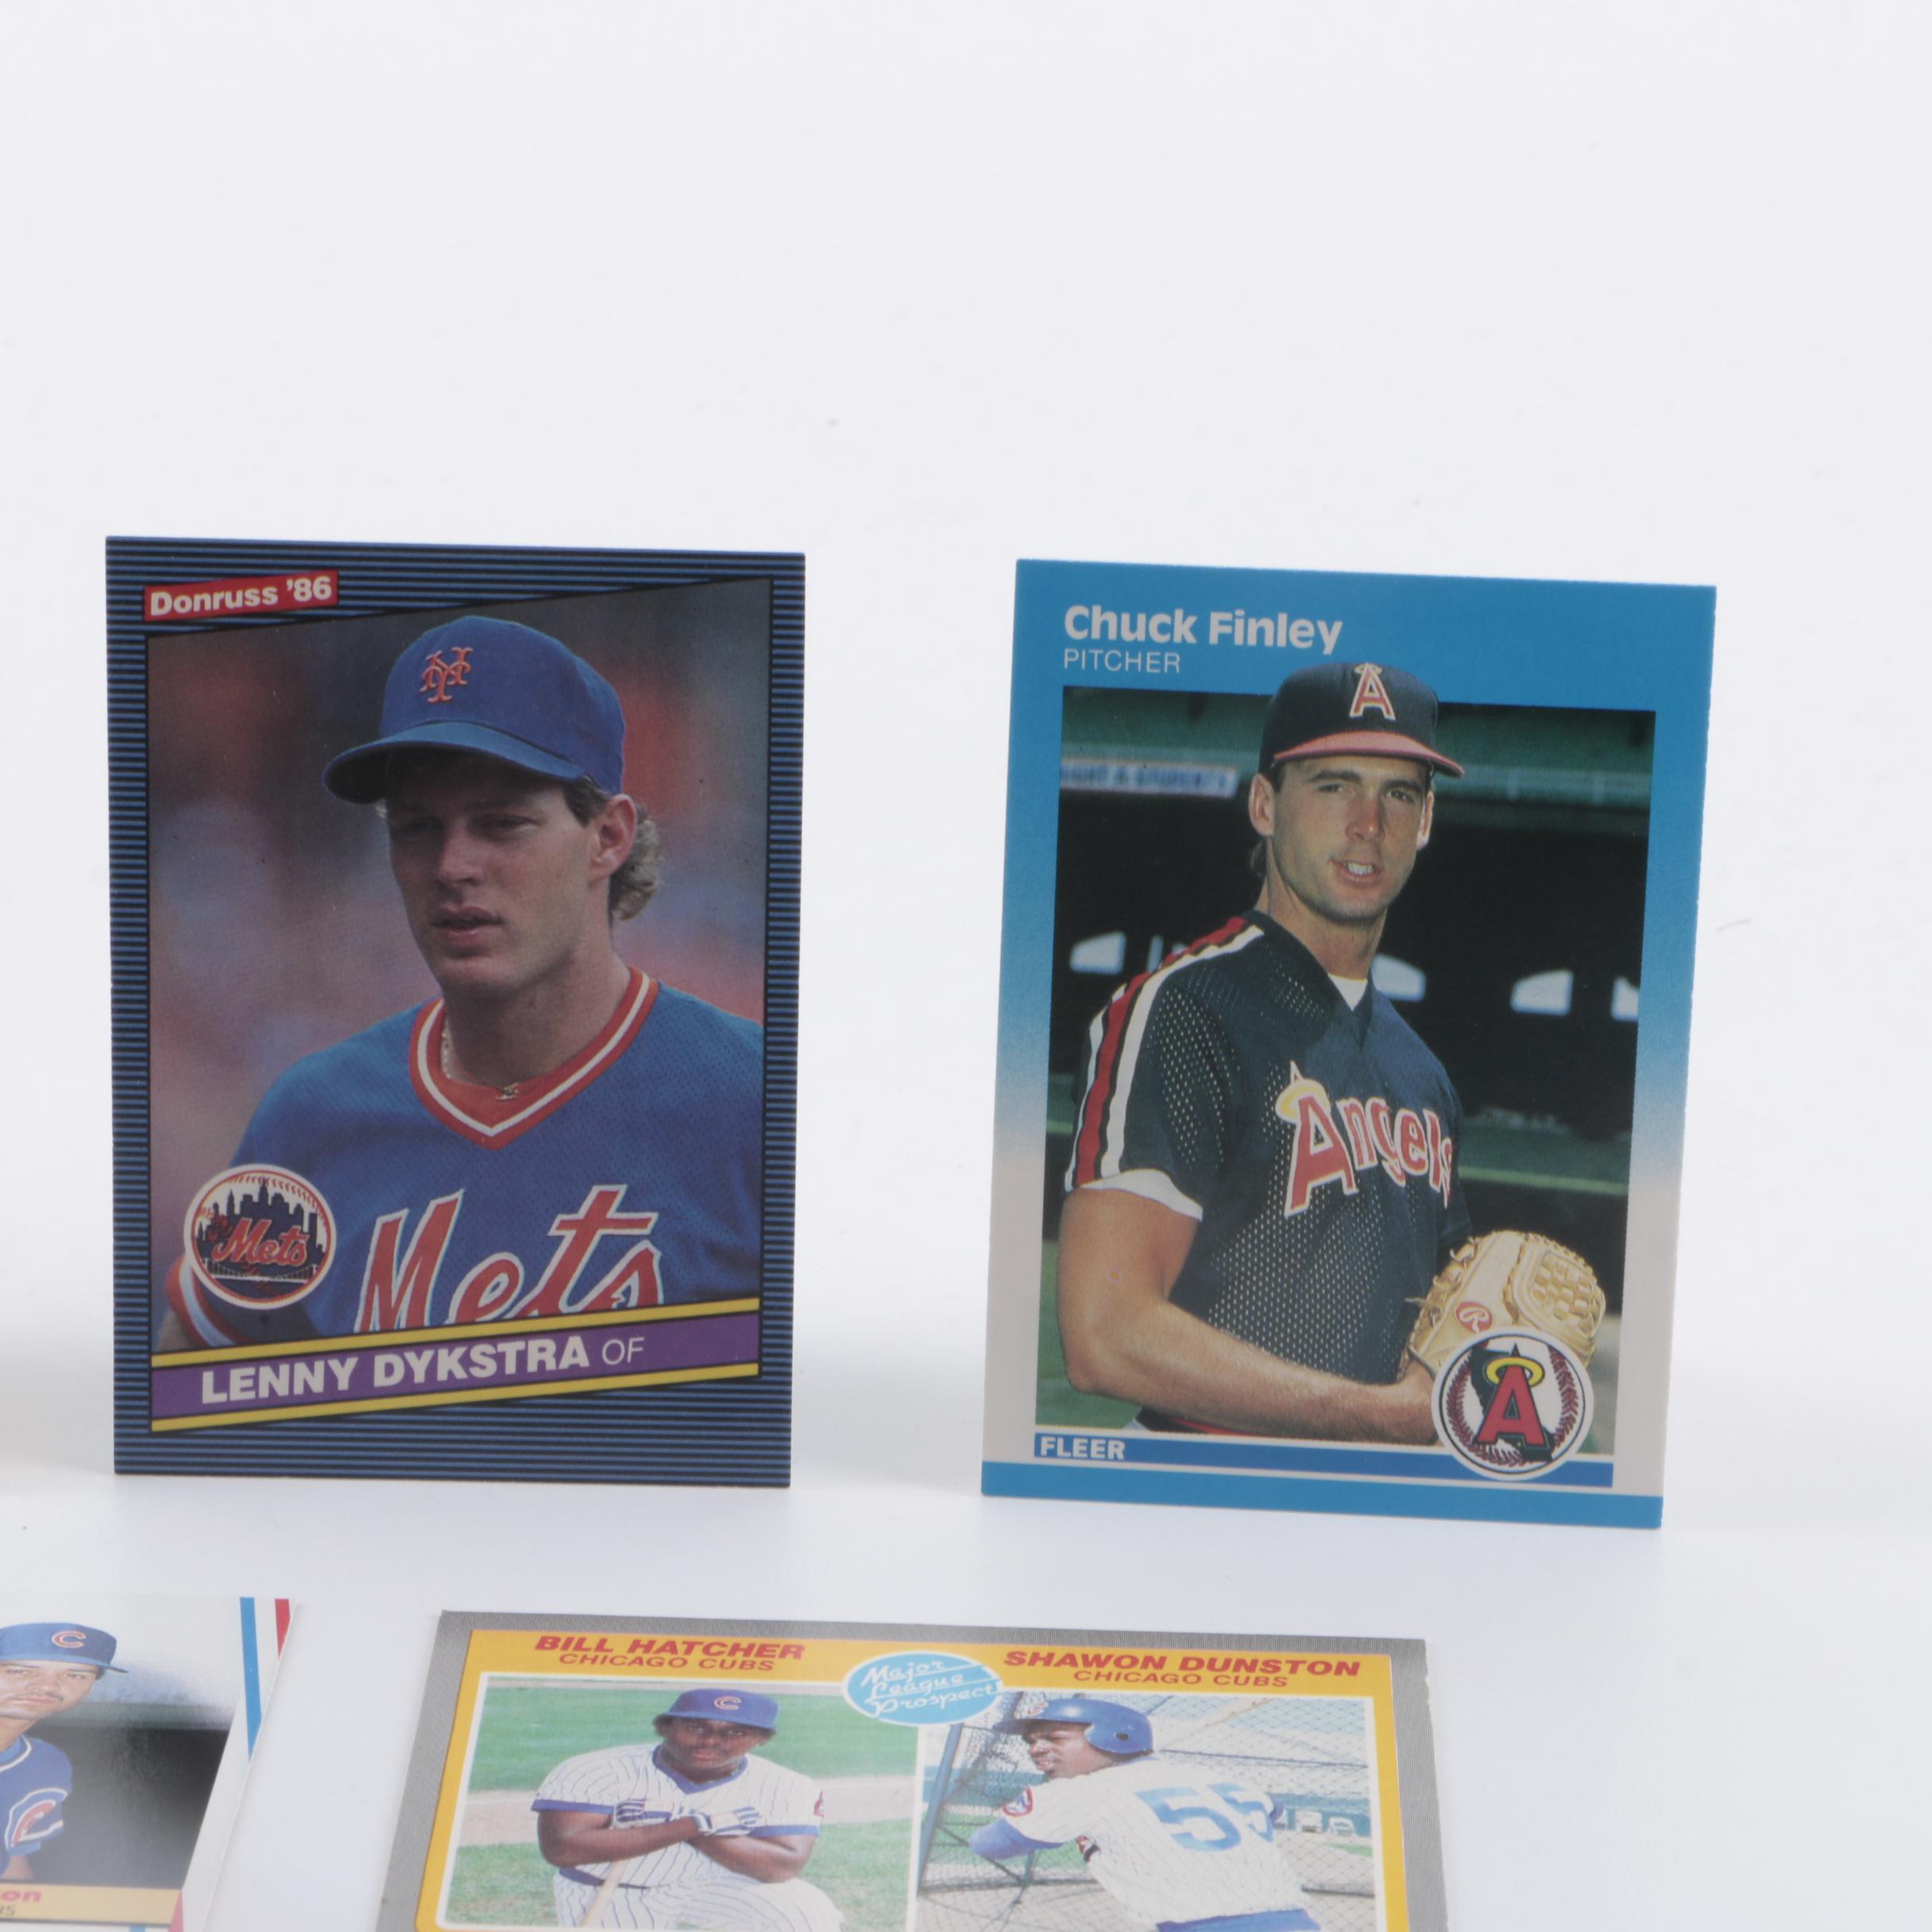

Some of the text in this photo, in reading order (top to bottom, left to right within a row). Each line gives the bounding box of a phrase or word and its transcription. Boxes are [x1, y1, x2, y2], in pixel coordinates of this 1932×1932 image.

[149, 576, 333, 616] Donruss '86
[1064, 605, 1343, 655] Chuck Finley
[1063, 648, 1181, 674] PITCHER
[1349, 663, 1396, 720] A
[1274, 1061, 1453, 1219] Angels
[211, 1217, 310, 1266] Mets
[202, 1335, 645, 1405] LENNY DYKSTRA OF
[1040, 1436, 1126, 1460] FLEER
[534, 1636, 806, 1660] BILL HATCHER
[558, 1654, 776, 1671] CHICAGO CUBS
[860, 1660, 945, 1687] Major
[1003, 1651, 1361, 1677] SHAWON DUNSTON
[864, 1673, 964, 1703] League
[1074, 1671, 1289, 1688] CHICAGO CUBS
